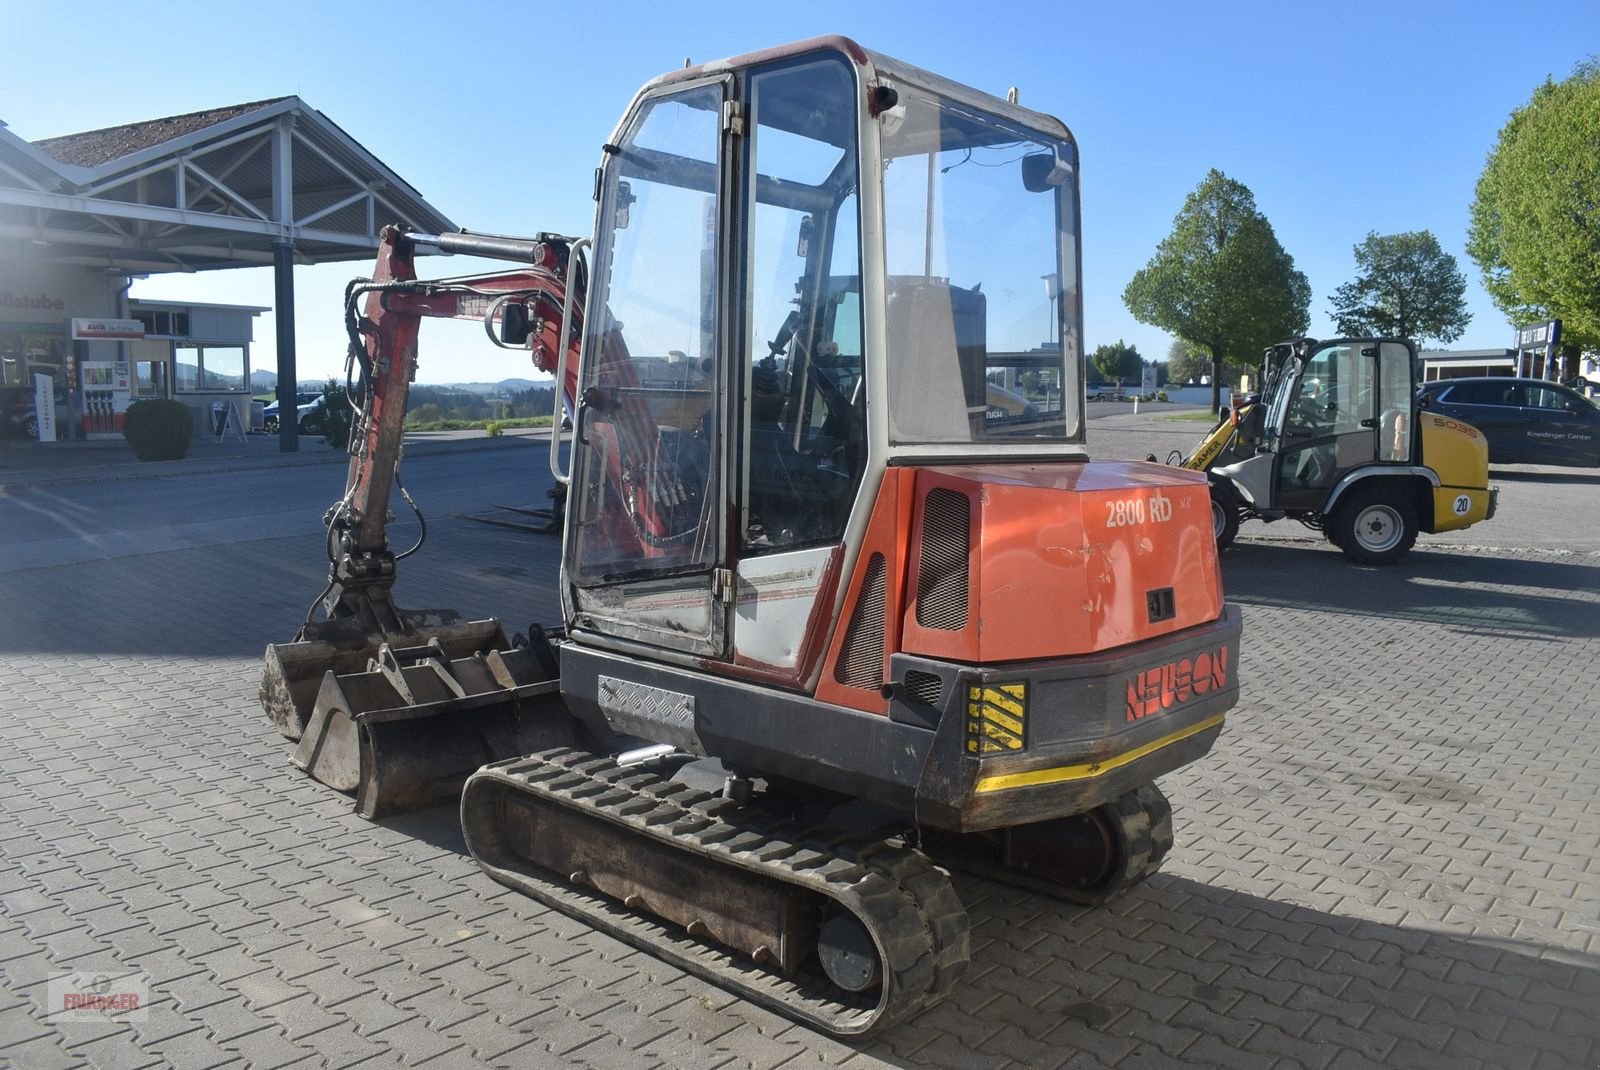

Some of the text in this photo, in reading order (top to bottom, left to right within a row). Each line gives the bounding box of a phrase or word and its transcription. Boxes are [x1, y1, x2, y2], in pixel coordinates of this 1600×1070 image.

[1434, 417, 1478, 439] 5035
[1526, 430, 1592, 441] Kneidinger Center
[1188, 440, 1221, 470] RAMER
[1105, 498, 1146, 528] 2800
[1149, 496, 1173, 523] RD
[1456, 497, 1468, 513] 20
[1125, 645, 1228, 722] NEUSON
